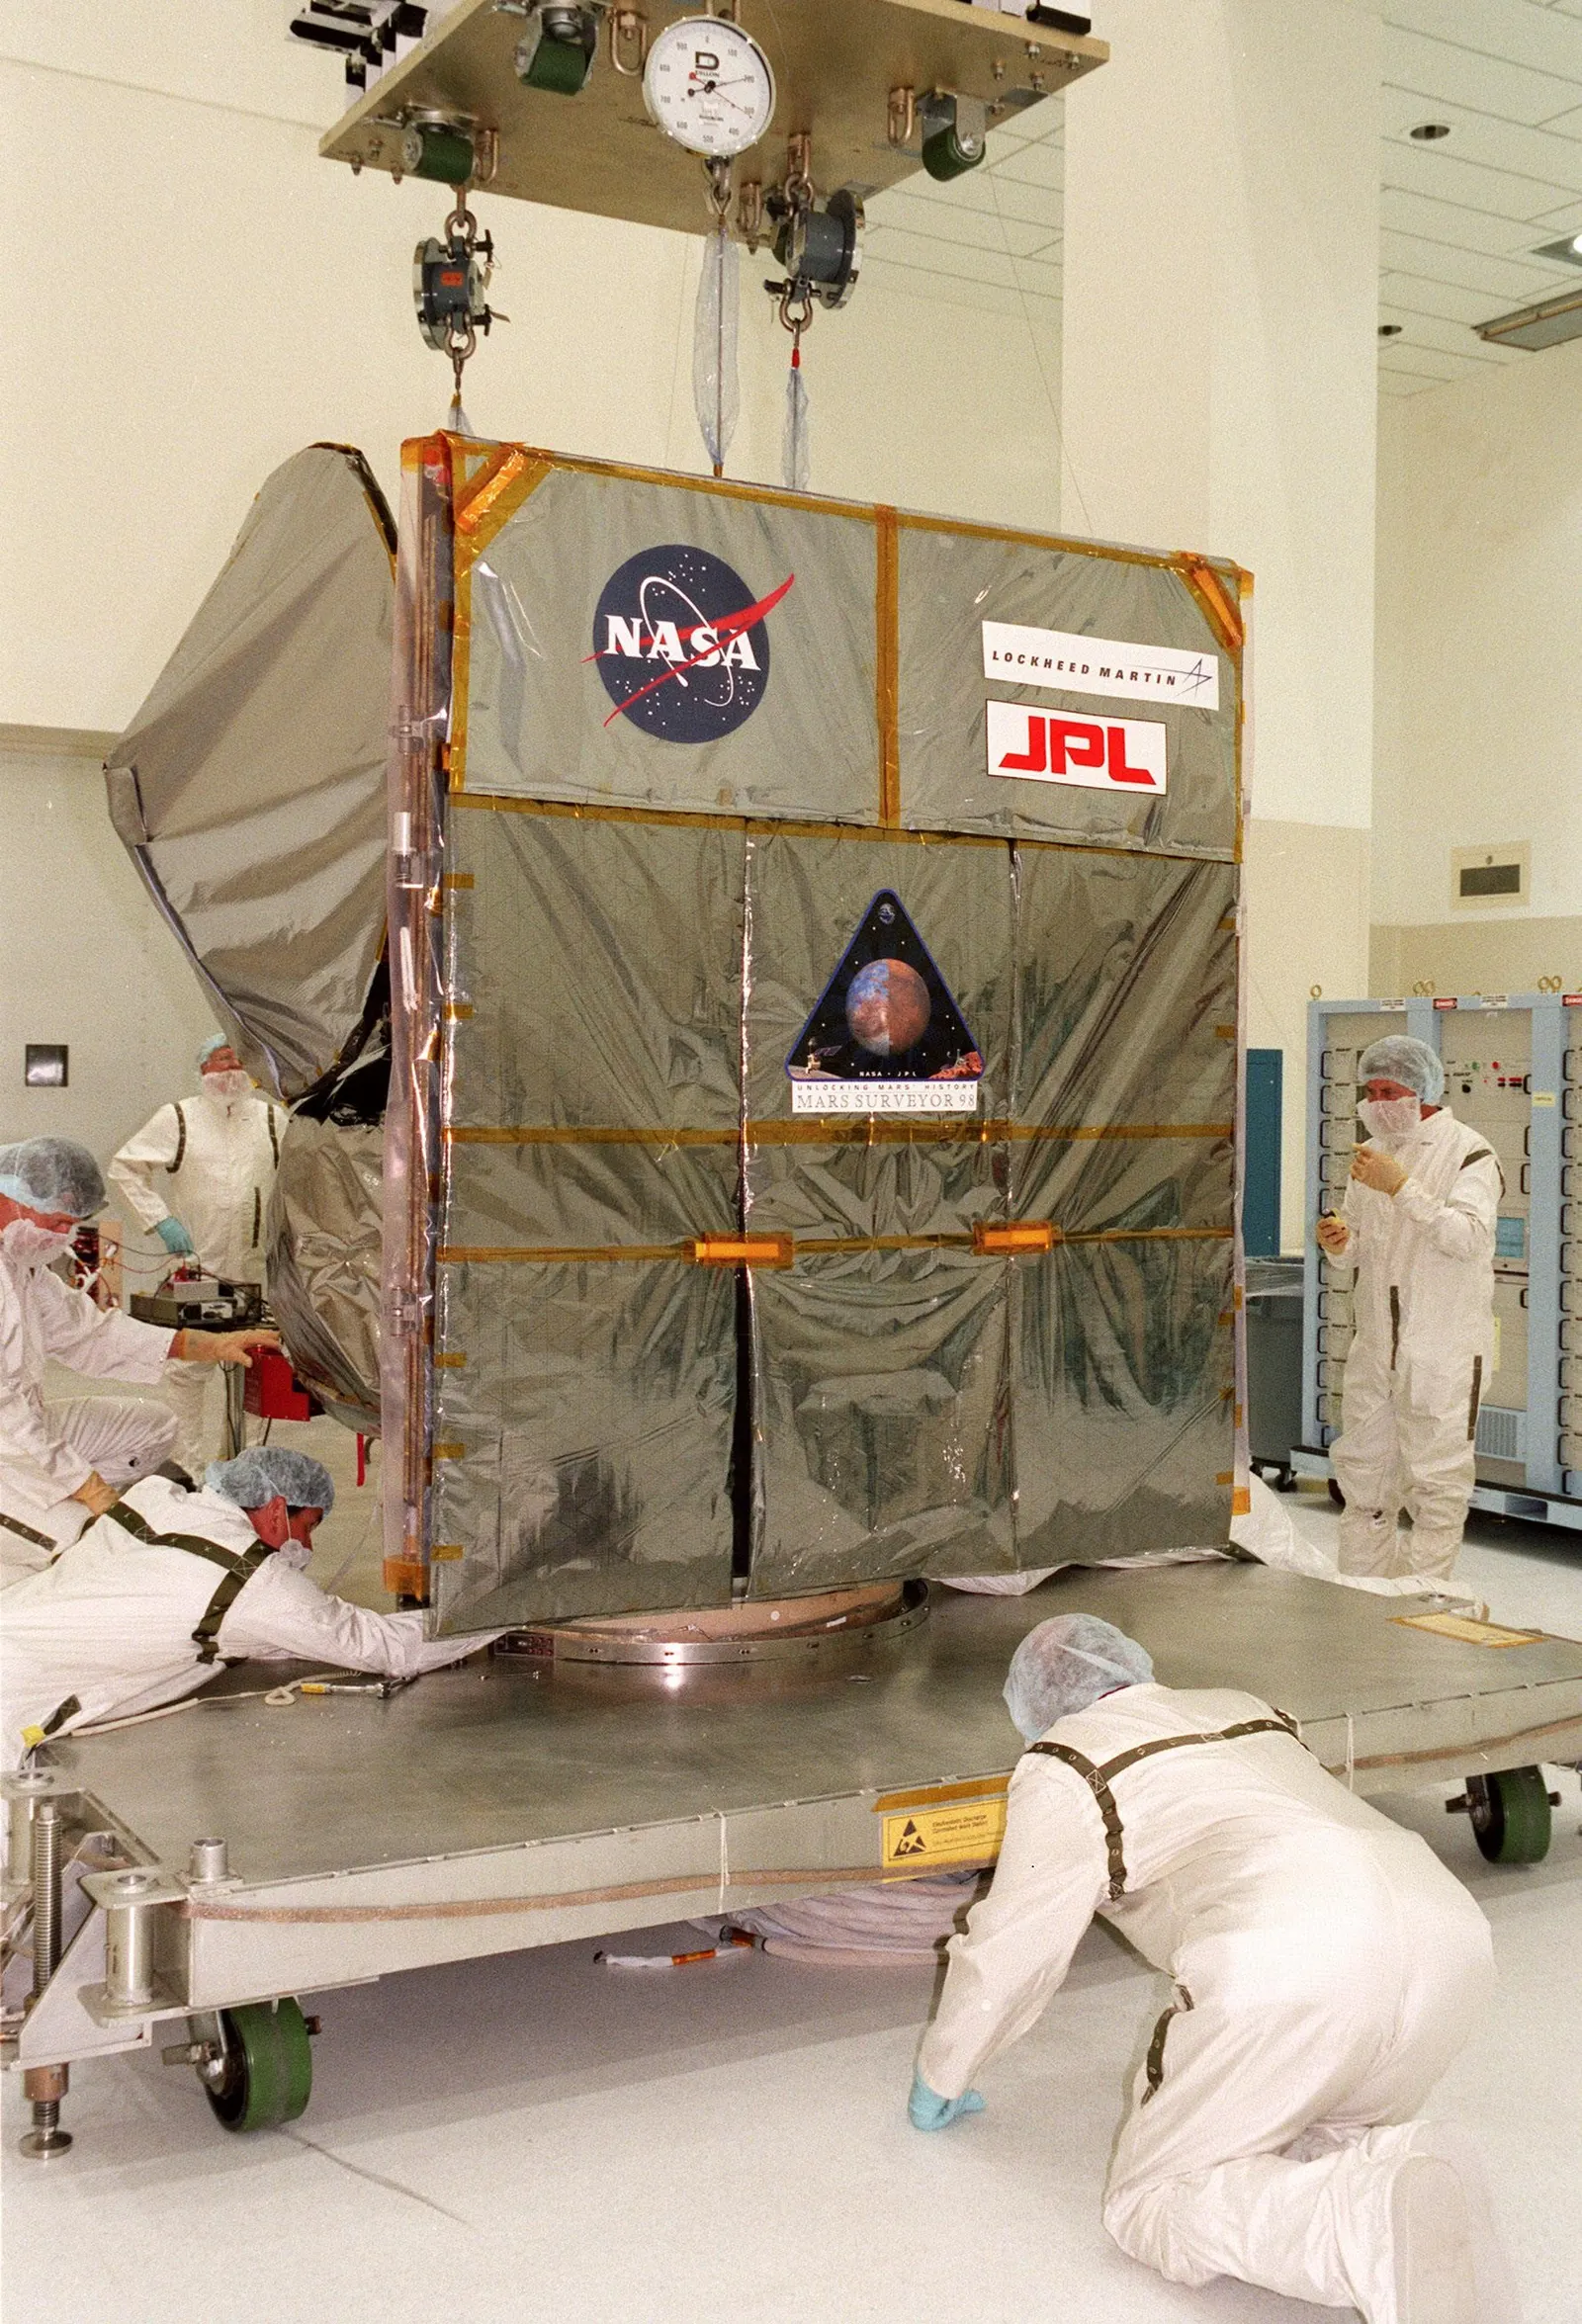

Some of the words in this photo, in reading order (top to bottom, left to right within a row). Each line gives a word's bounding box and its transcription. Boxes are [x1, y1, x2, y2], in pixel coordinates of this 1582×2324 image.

[695, 51, 720, 70] D
[660, 95, 671, 104] 700
[603, 614, 761, 671] NASA
[993, 650, 1090, 674] LOCKHEED
[1099, 667, 1176, 686] MARTIN
[999, 715, 1157, 786] JPL
[797, 1094, 849, 1109] MARS
[855, 1093, 954, 1108] SURVEYOR
[959, 1094, 975, 1107] 98
